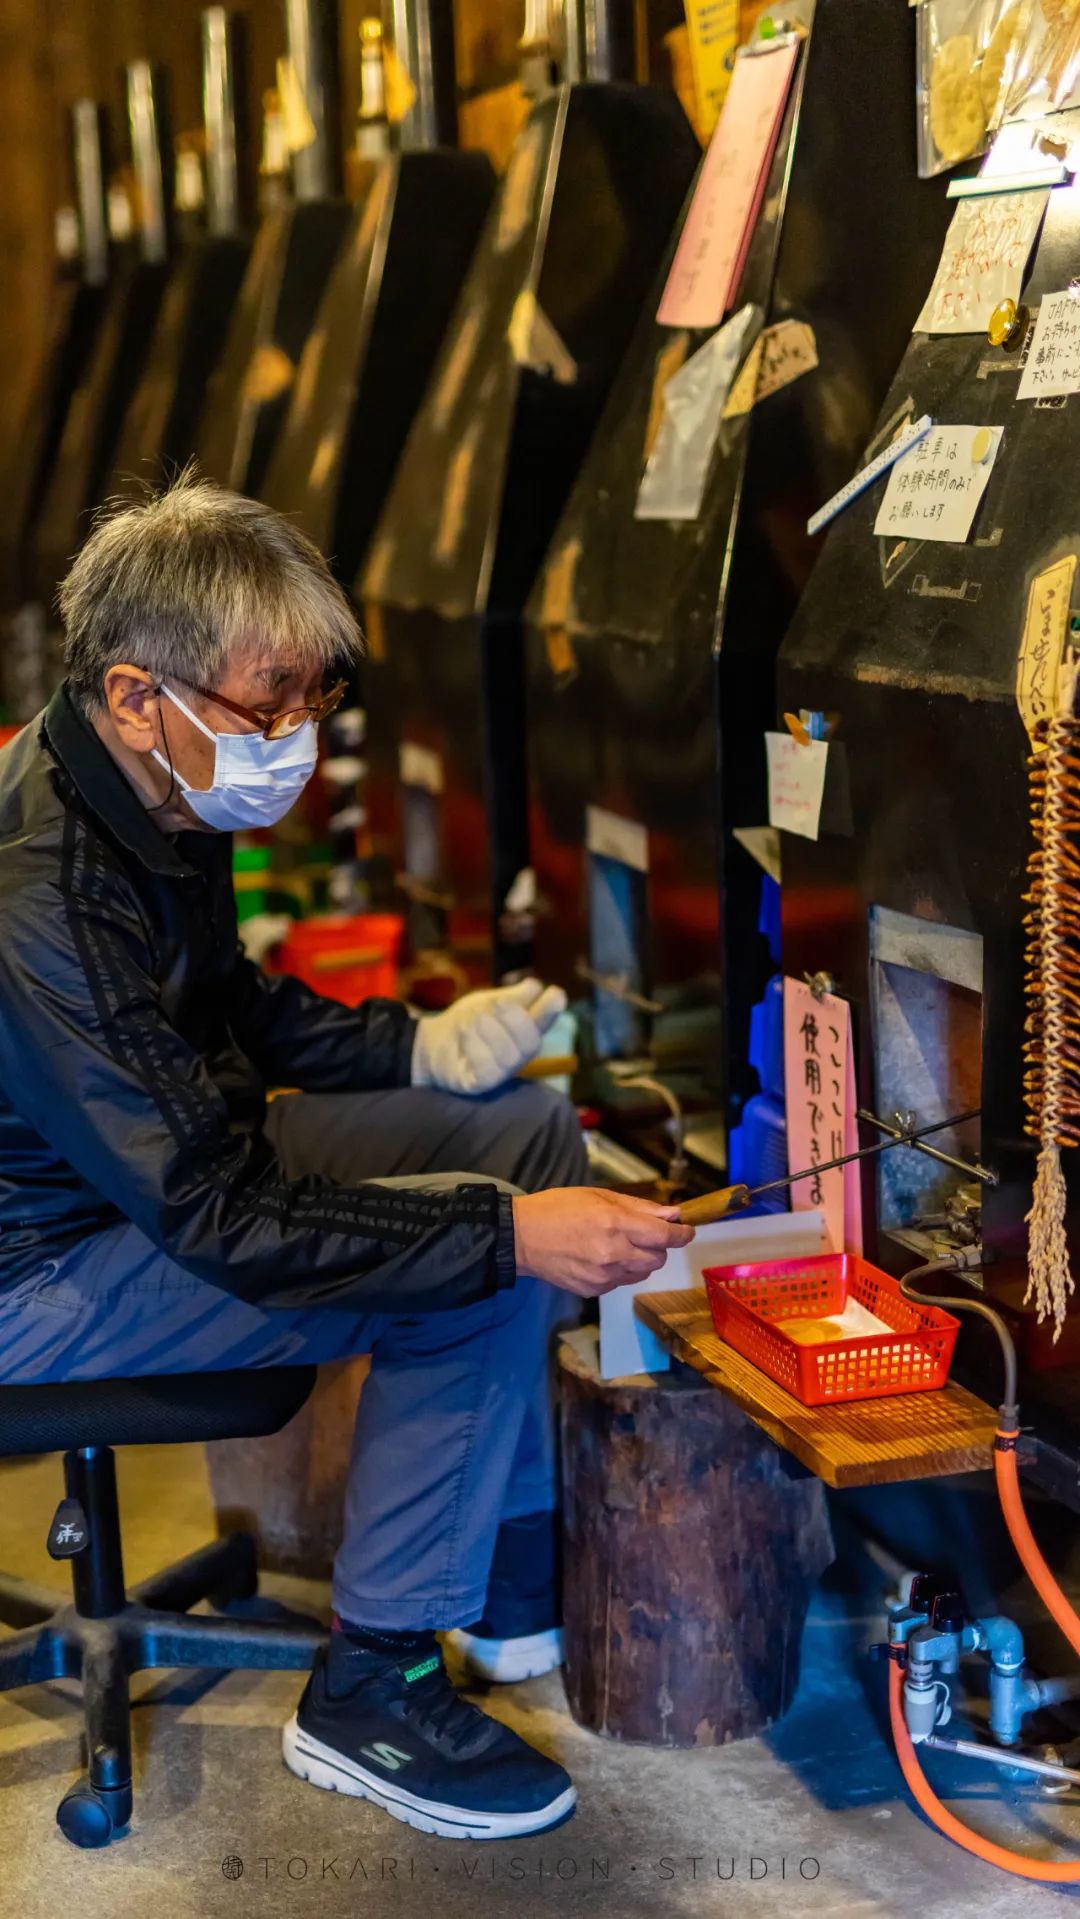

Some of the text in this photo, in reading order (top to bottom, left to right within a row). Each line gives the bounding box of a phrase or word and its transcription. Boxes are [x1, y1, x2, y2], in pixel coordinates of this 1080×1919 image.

[888, 500, 946, 522] お願いします
